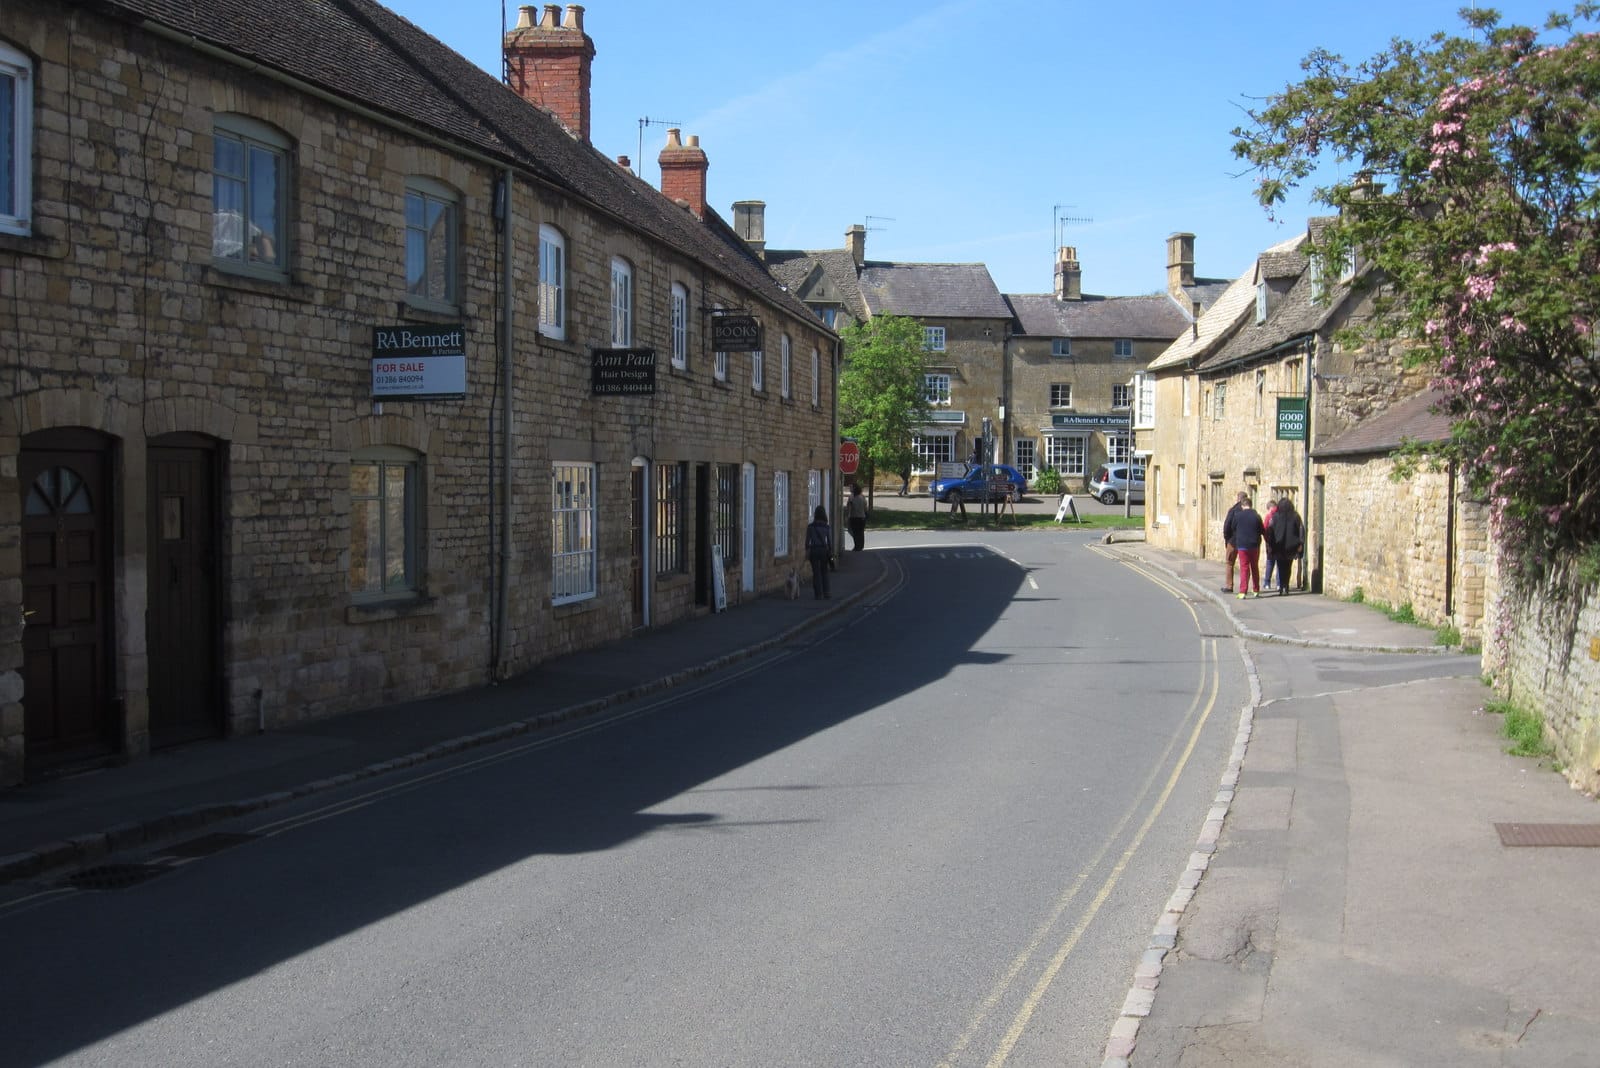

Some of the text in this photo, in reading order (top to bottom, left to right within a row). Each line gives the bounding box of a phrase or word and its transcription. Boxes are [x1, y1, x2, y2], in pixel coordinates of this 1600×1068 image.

[715, 326, 757, 337] BOOKS
[400, 331, 461, 348] Bennett
[594, 352, 655, 366] Ann Paul
[376, 362, 425, 373] FOR SALE
[601, 370, 648, 380] Hair Design
[595, 384, 621, 392] 01386
[1279, 413, 1304, 421] GOOD
[1279, 422, 1303, 430] FOOD
[840, 453, 860, 463] STOP
